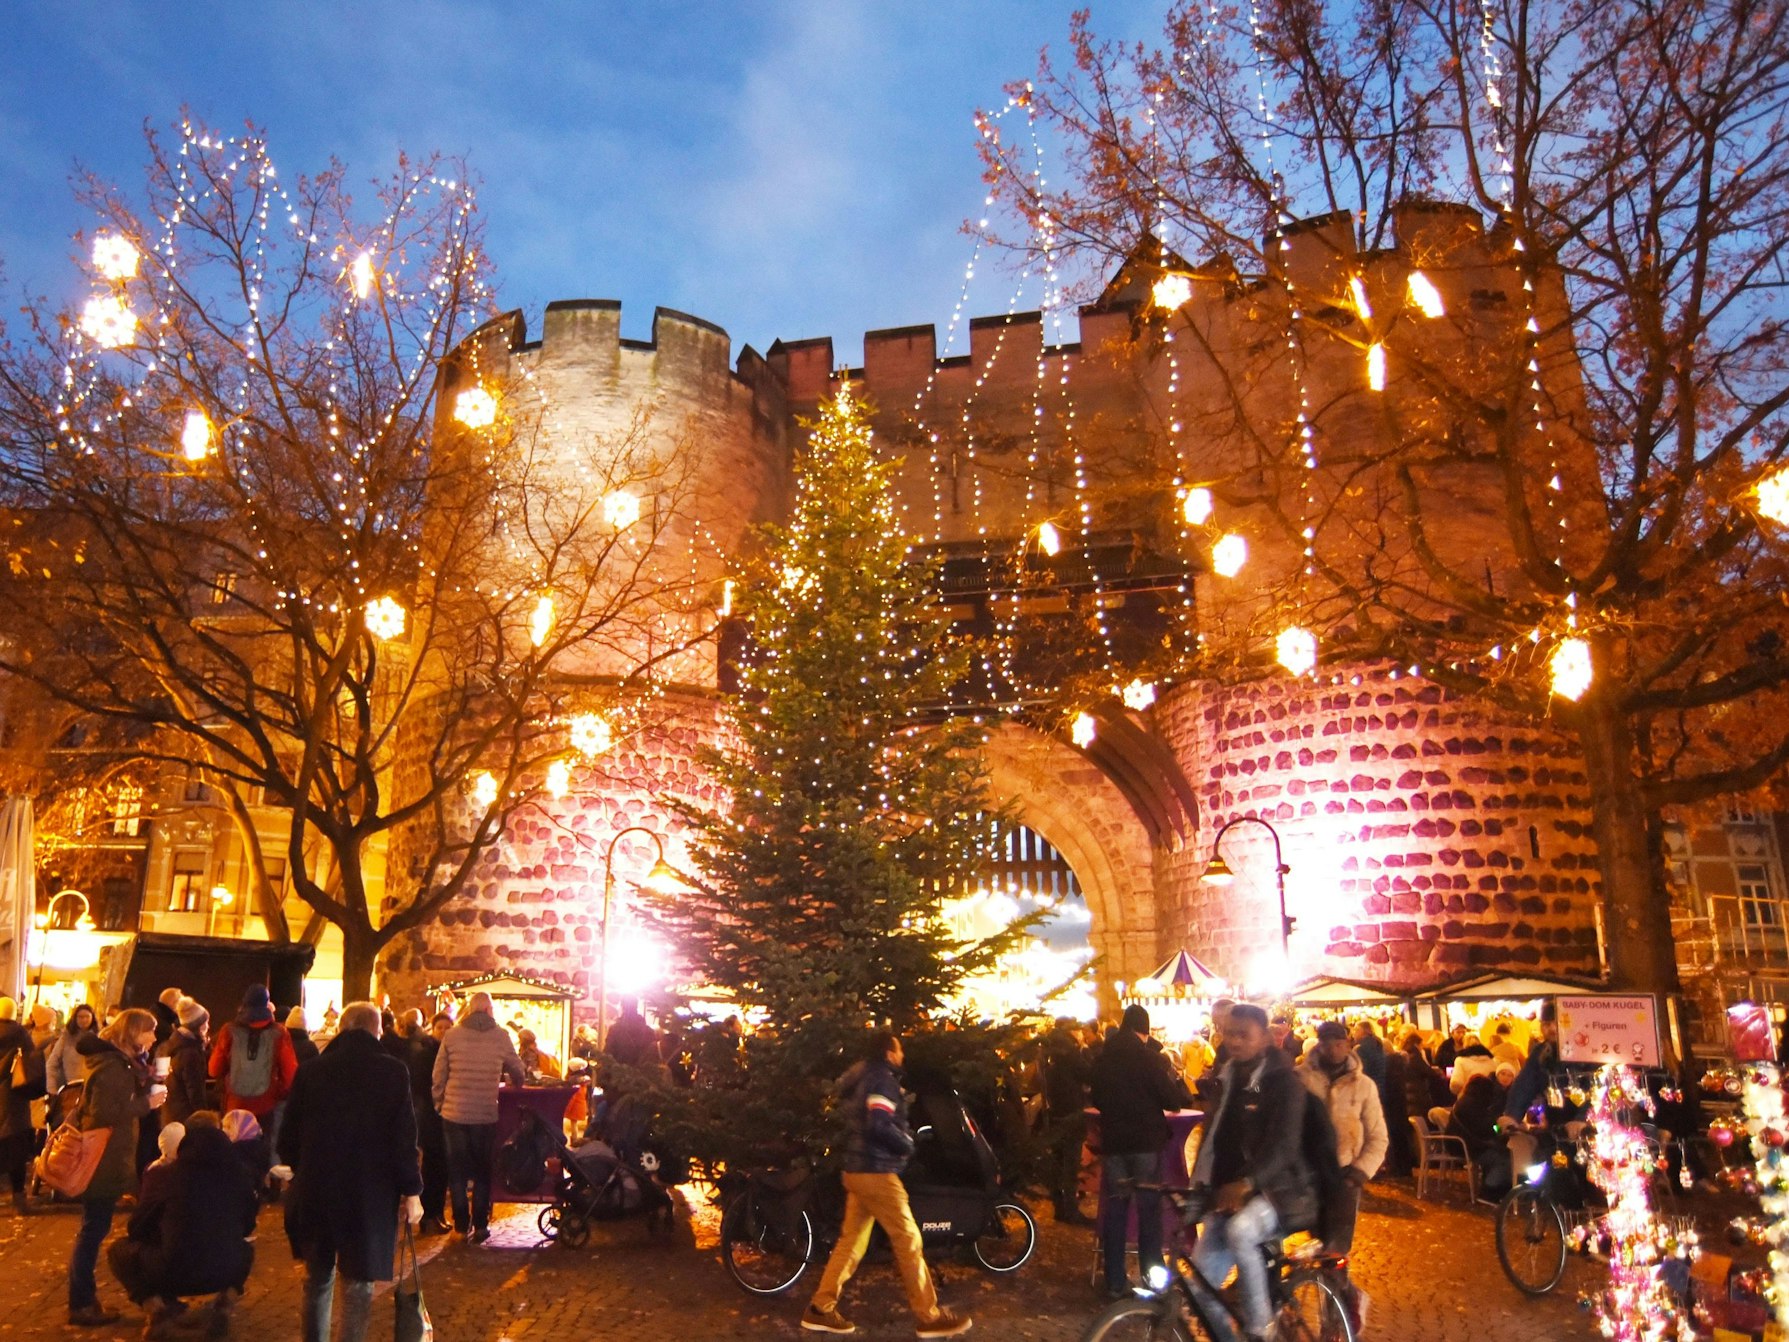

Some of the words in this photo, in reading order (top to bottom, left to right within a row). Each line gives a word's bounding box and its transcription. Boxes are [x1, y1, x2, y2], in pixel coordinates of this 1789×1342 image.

[1613, 1001, 1645, 1010] KUGEL
[1592, 1021, 1627, 1030] Figuren
[1601, 1043, 1609, 1054] 2
[1613, 1043, 1621, 1054] €
